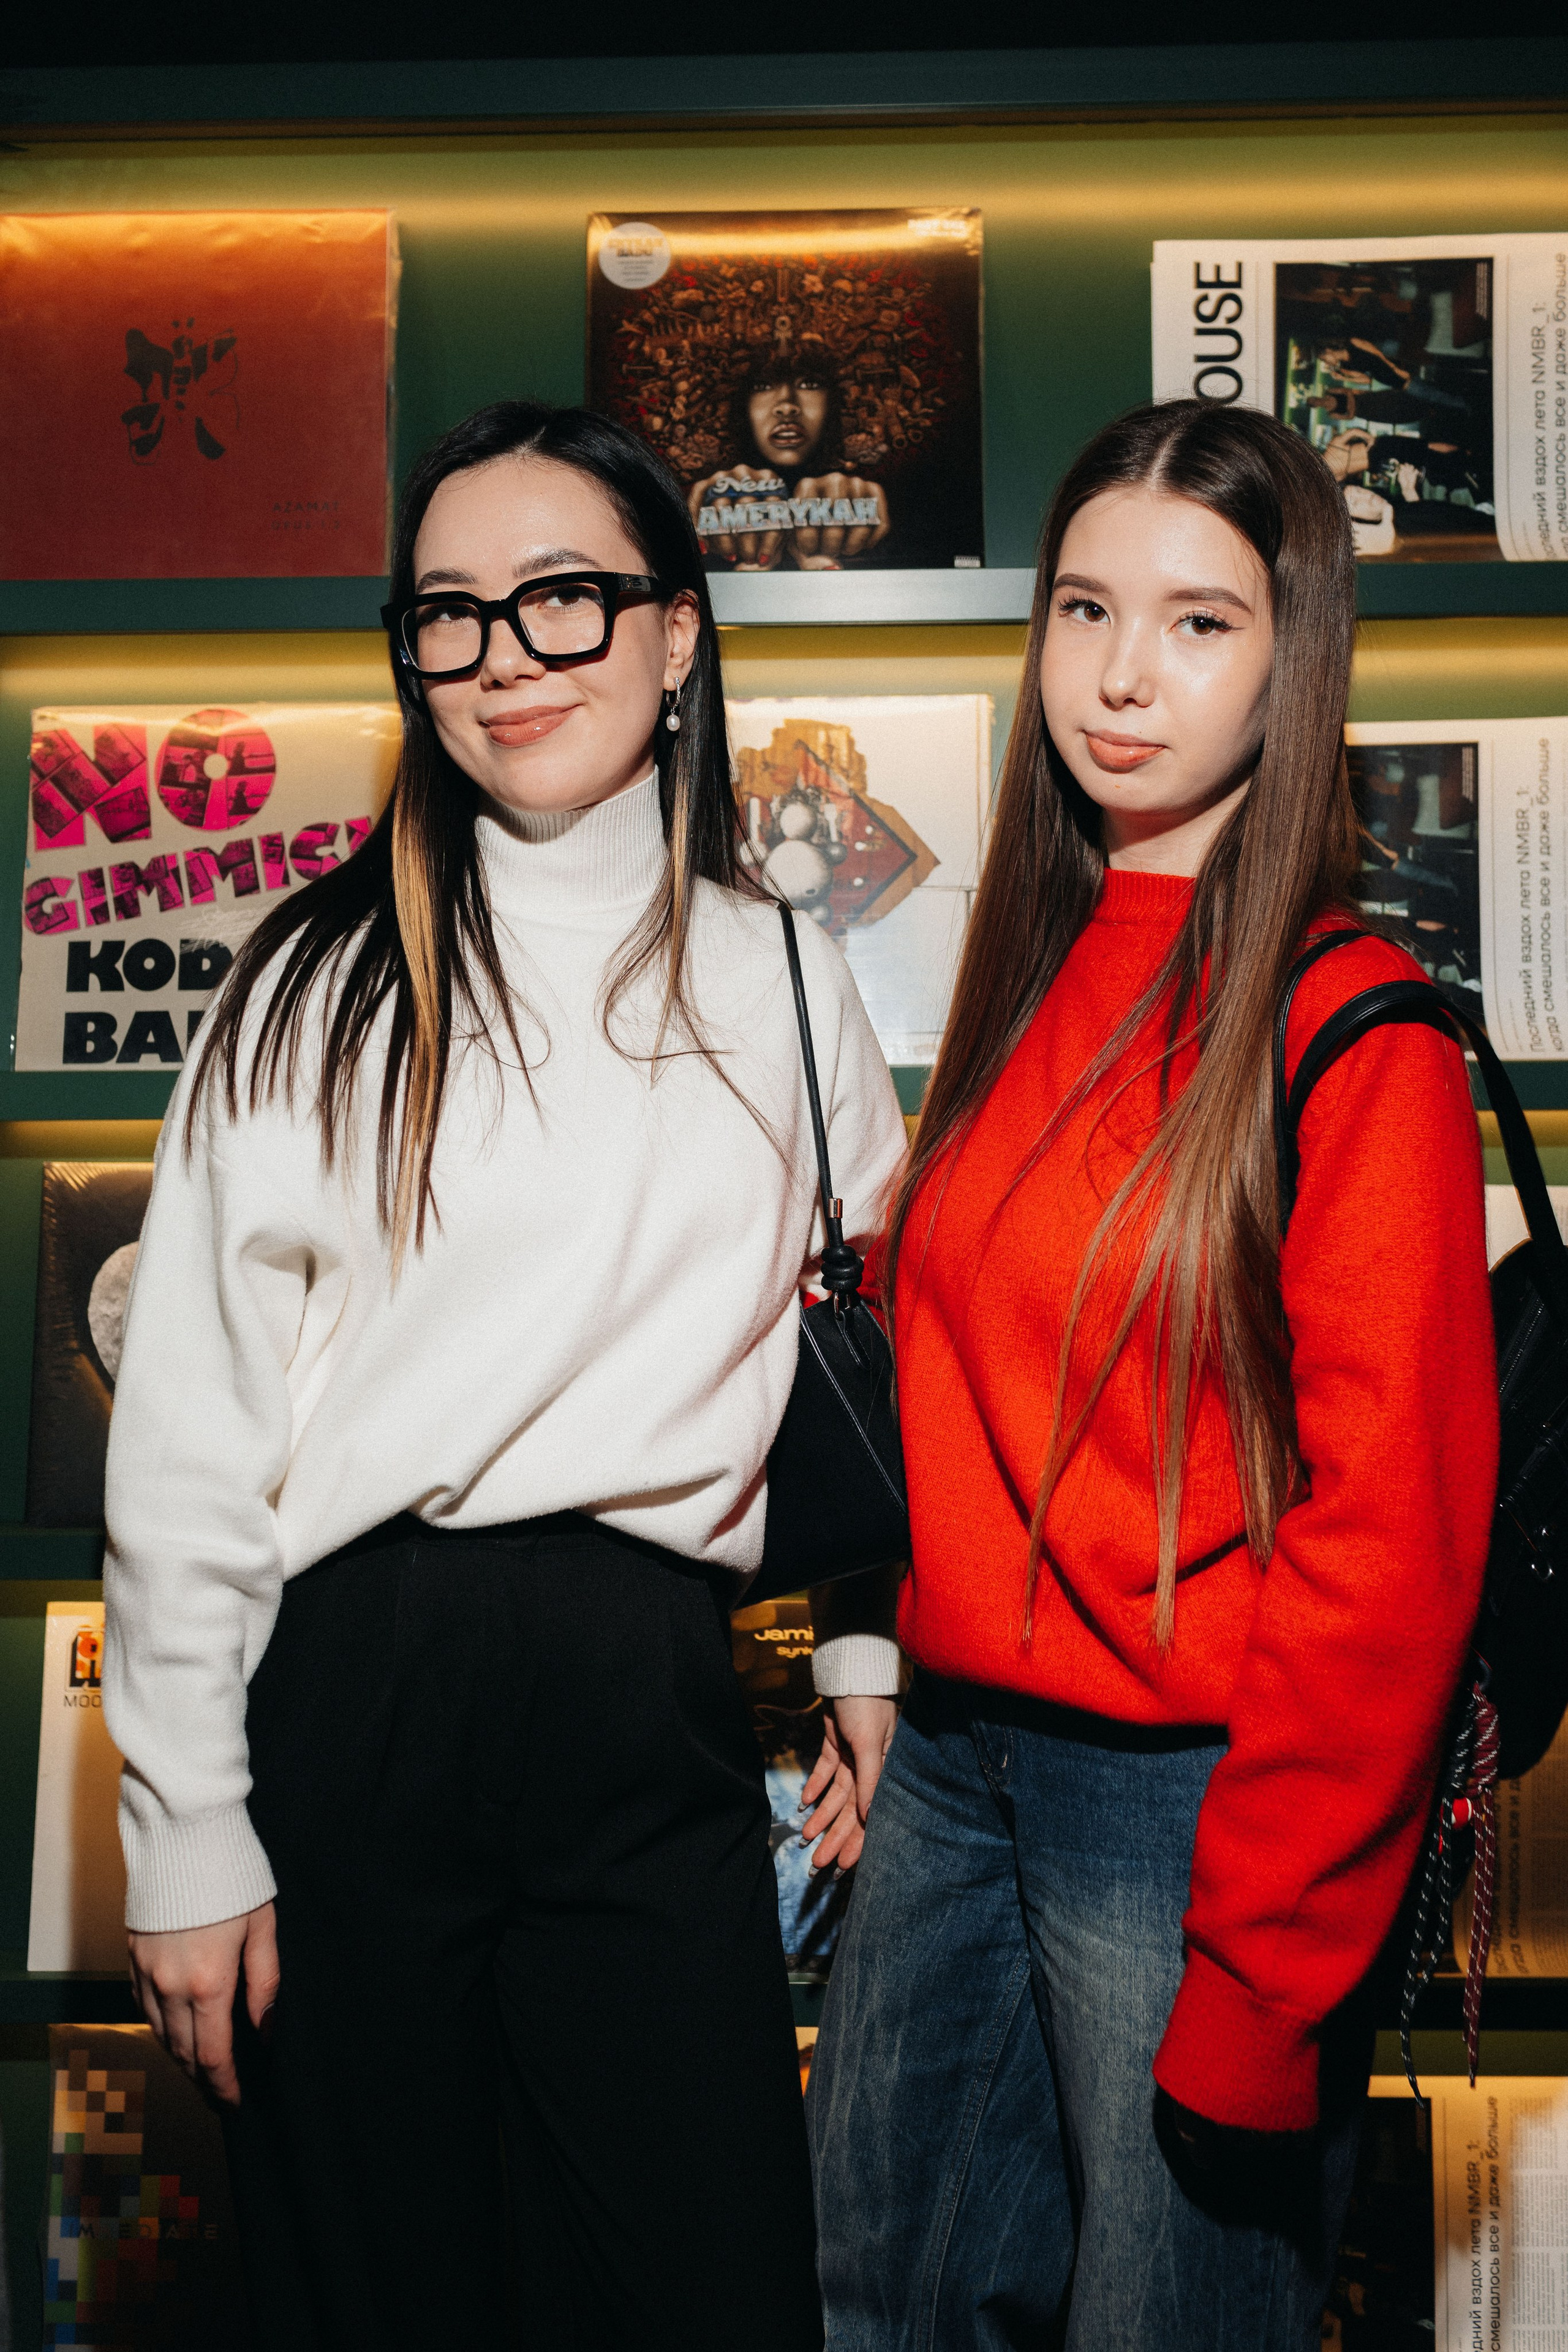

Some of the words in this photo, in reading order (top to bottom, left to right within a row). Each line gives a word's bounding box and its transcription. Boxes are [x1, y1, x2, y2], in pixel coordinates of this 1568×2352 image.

[1553, 253, 1567, 322] больше
[1194, 262, 1242, 405] OUSE
[1555, 328, 1568, 375] даже
[1556, 380, 1566, 391] и
[1535, 390, 1546, 430] лета
[1556, 397, 1566, 428] все
[1536, 435, 1548, 486] вздох
[712, 475, 785, 492] New
[697, 497, 881, 535] AMERYKAH
[31, 708, 276, 853] NO
[1536, 737, 1550, 805] больше
[1539, 810, 1551, 856] даже
[1540, 861, 1550, 872] и
[1520, 870, 1531, 909] лета
[1540, 876, 1551, 907] все
[1521, 914, 1532, 964] вздох
[1541, 911, 1555, 1012] смешалось
[1520, 968, 1545, 1053] Последний
[1485, 2096, 1499, 2160] больше
[1488, 2164, 1500, 2207] даже
[1471, 2218, 1482, 2255] лета
[1490, 2211, 1499, 2220] и
[1490, 2225, 1499, 2253] все
[1472, 2260, 1483, 2304] вздох
[1490, 2257, 1501, 2352] смешалось
